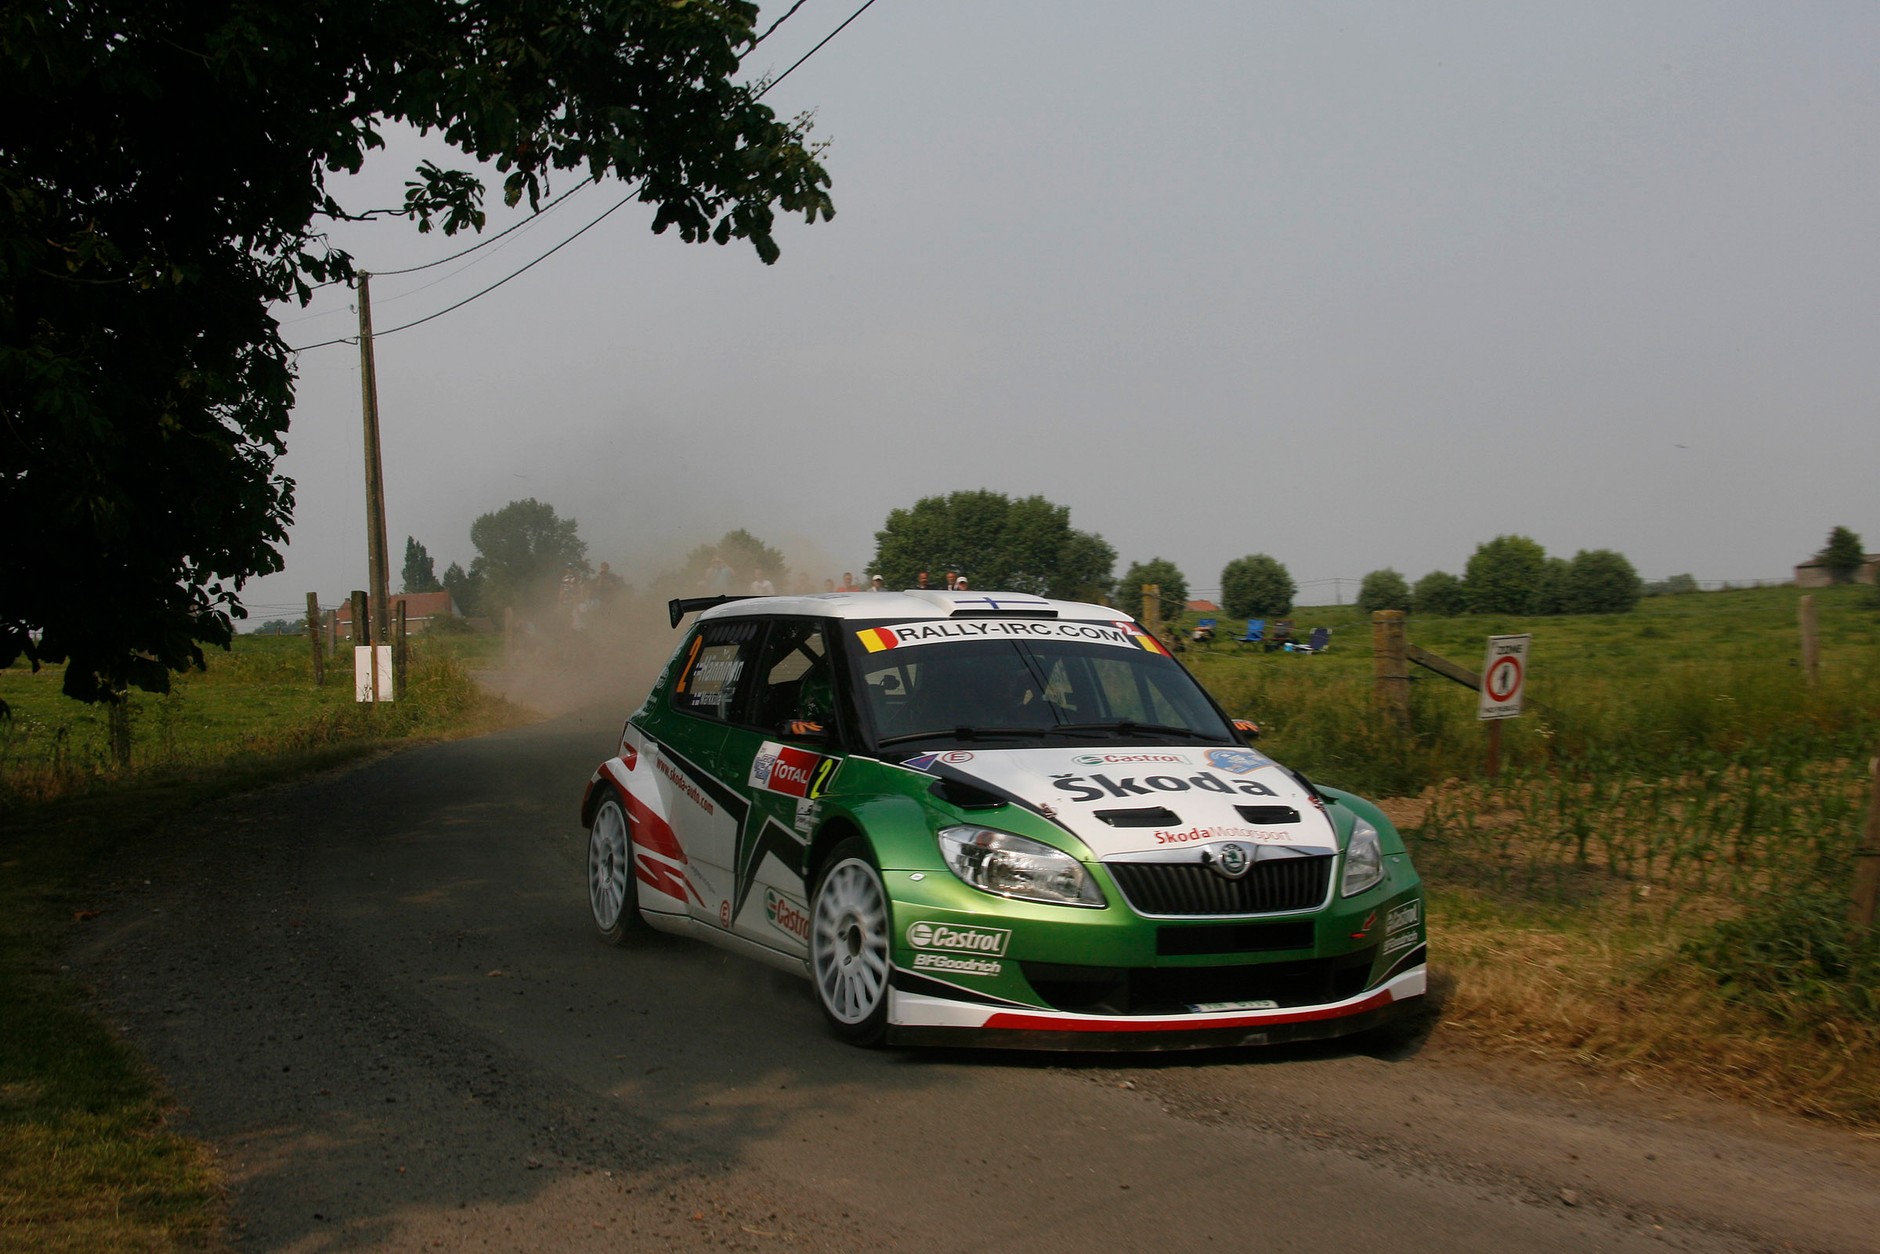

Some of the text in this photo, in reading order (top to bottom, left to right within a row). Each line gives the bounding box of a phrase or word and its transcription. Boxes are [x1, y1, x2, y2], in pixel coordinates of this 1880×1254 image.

[896, 622, 1126, 643] RALLY-IRC.COM
[676, 634, 703, 693] 2
[774, 759, 808, 784] TOTAL
[1104, 754, 1182, 763] Castrol
[810, 758, 833, 799] 2
[1048, 771, 1280, 802] Škoda
[777, 899, 810, 940] Castro
[931, 926, 1002, 952] Castrol
[914, 953, 1002, 973] BFGoodrich
